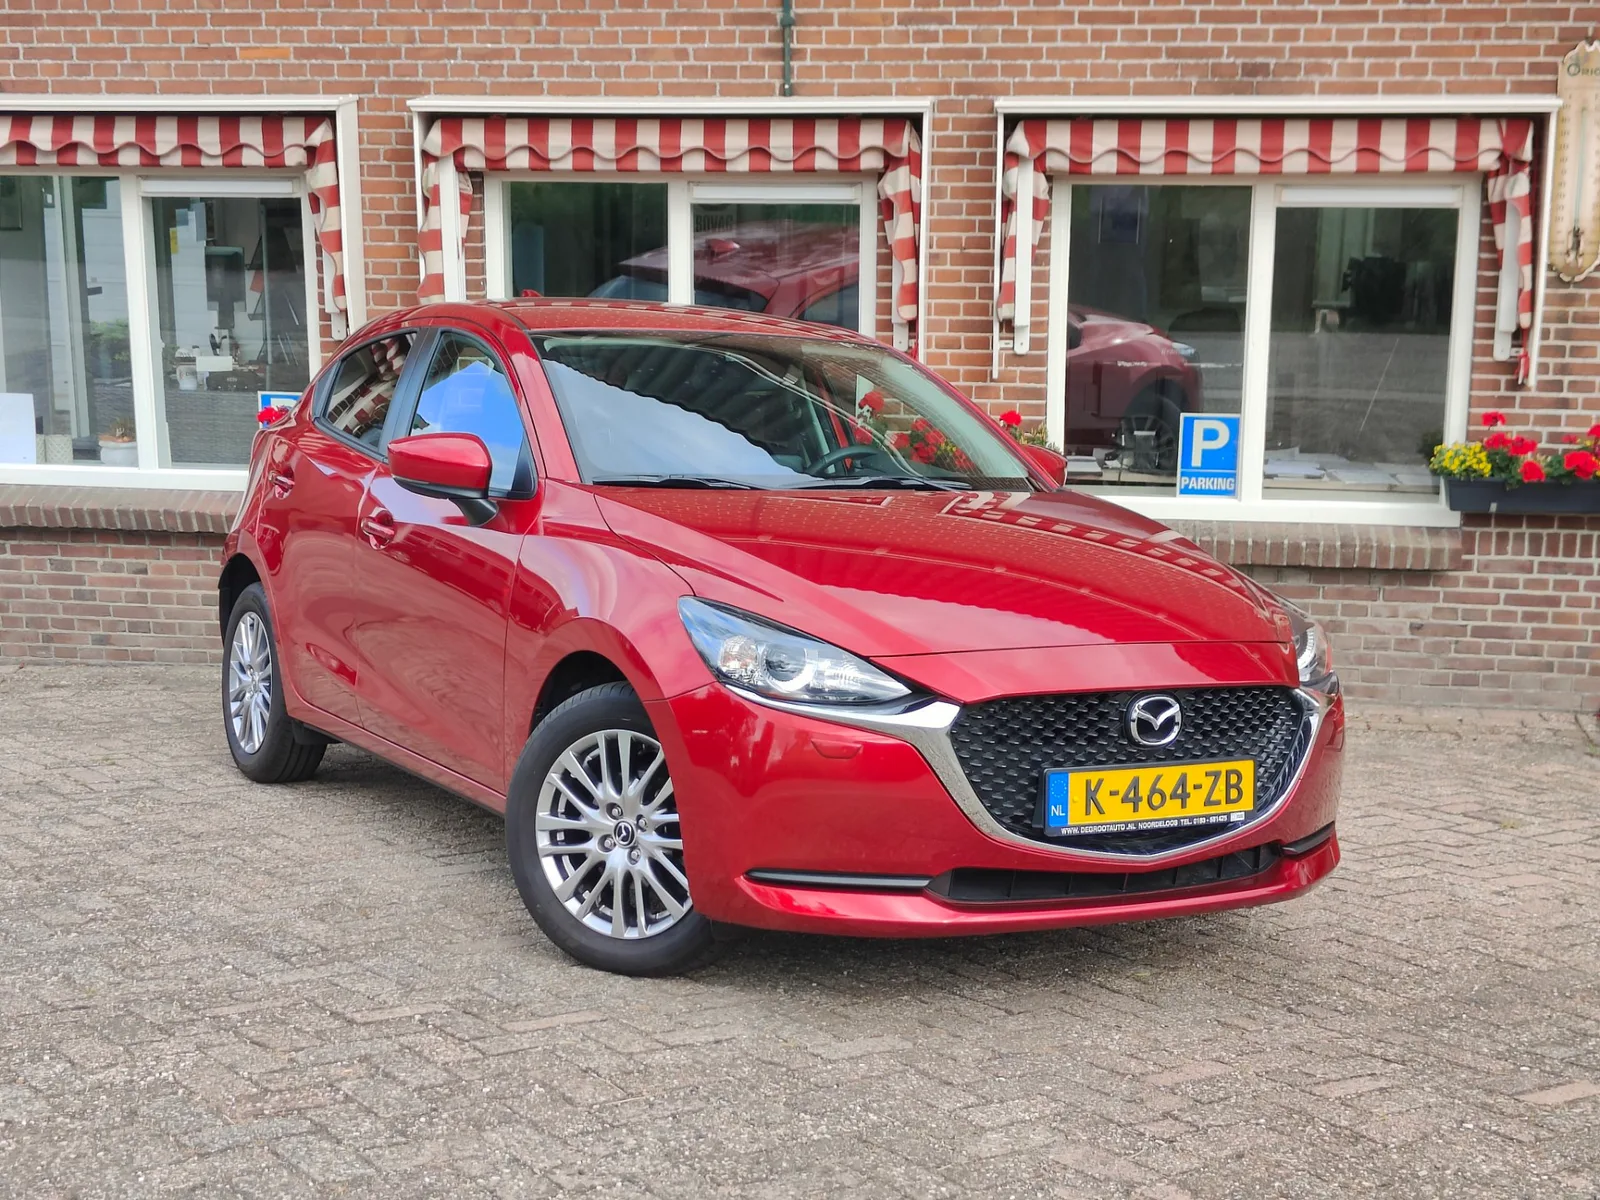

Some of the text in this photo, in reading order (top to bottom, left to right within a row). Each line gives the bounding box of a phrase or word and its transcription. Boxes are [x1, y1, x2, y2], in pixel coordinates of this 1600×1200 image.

[1191, 419, 1230, 468] P
[1181, 476, 1235, 490] PARKING
[1084, 769, 1243, 816] K-464-ZB
[1051, 805, 1066, 817] NL
